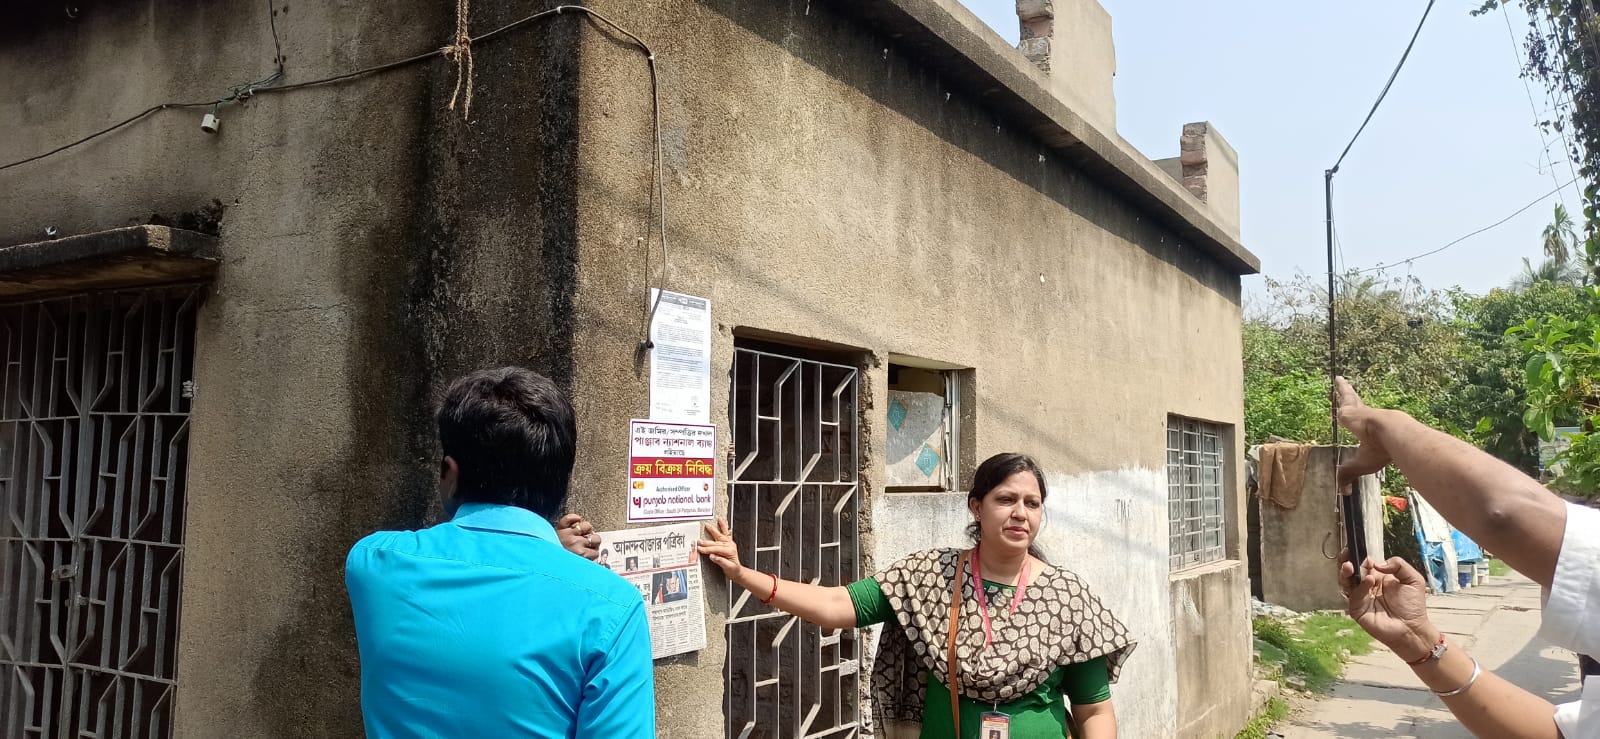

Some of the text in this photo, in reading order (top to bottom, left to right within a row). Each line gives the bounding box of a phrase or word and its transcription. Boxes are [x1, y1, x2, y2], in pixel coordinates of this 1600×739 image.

[663, 438, 694, 448] ন্যাশনাল
[632, 459, 713, 475] ক্রয় বিক্রয় নিষিদ্ধ
[643, 493, 711, 508] punjab national bank
[613, 531, 686, 555] আনন্দবাজার পত্রিকা
